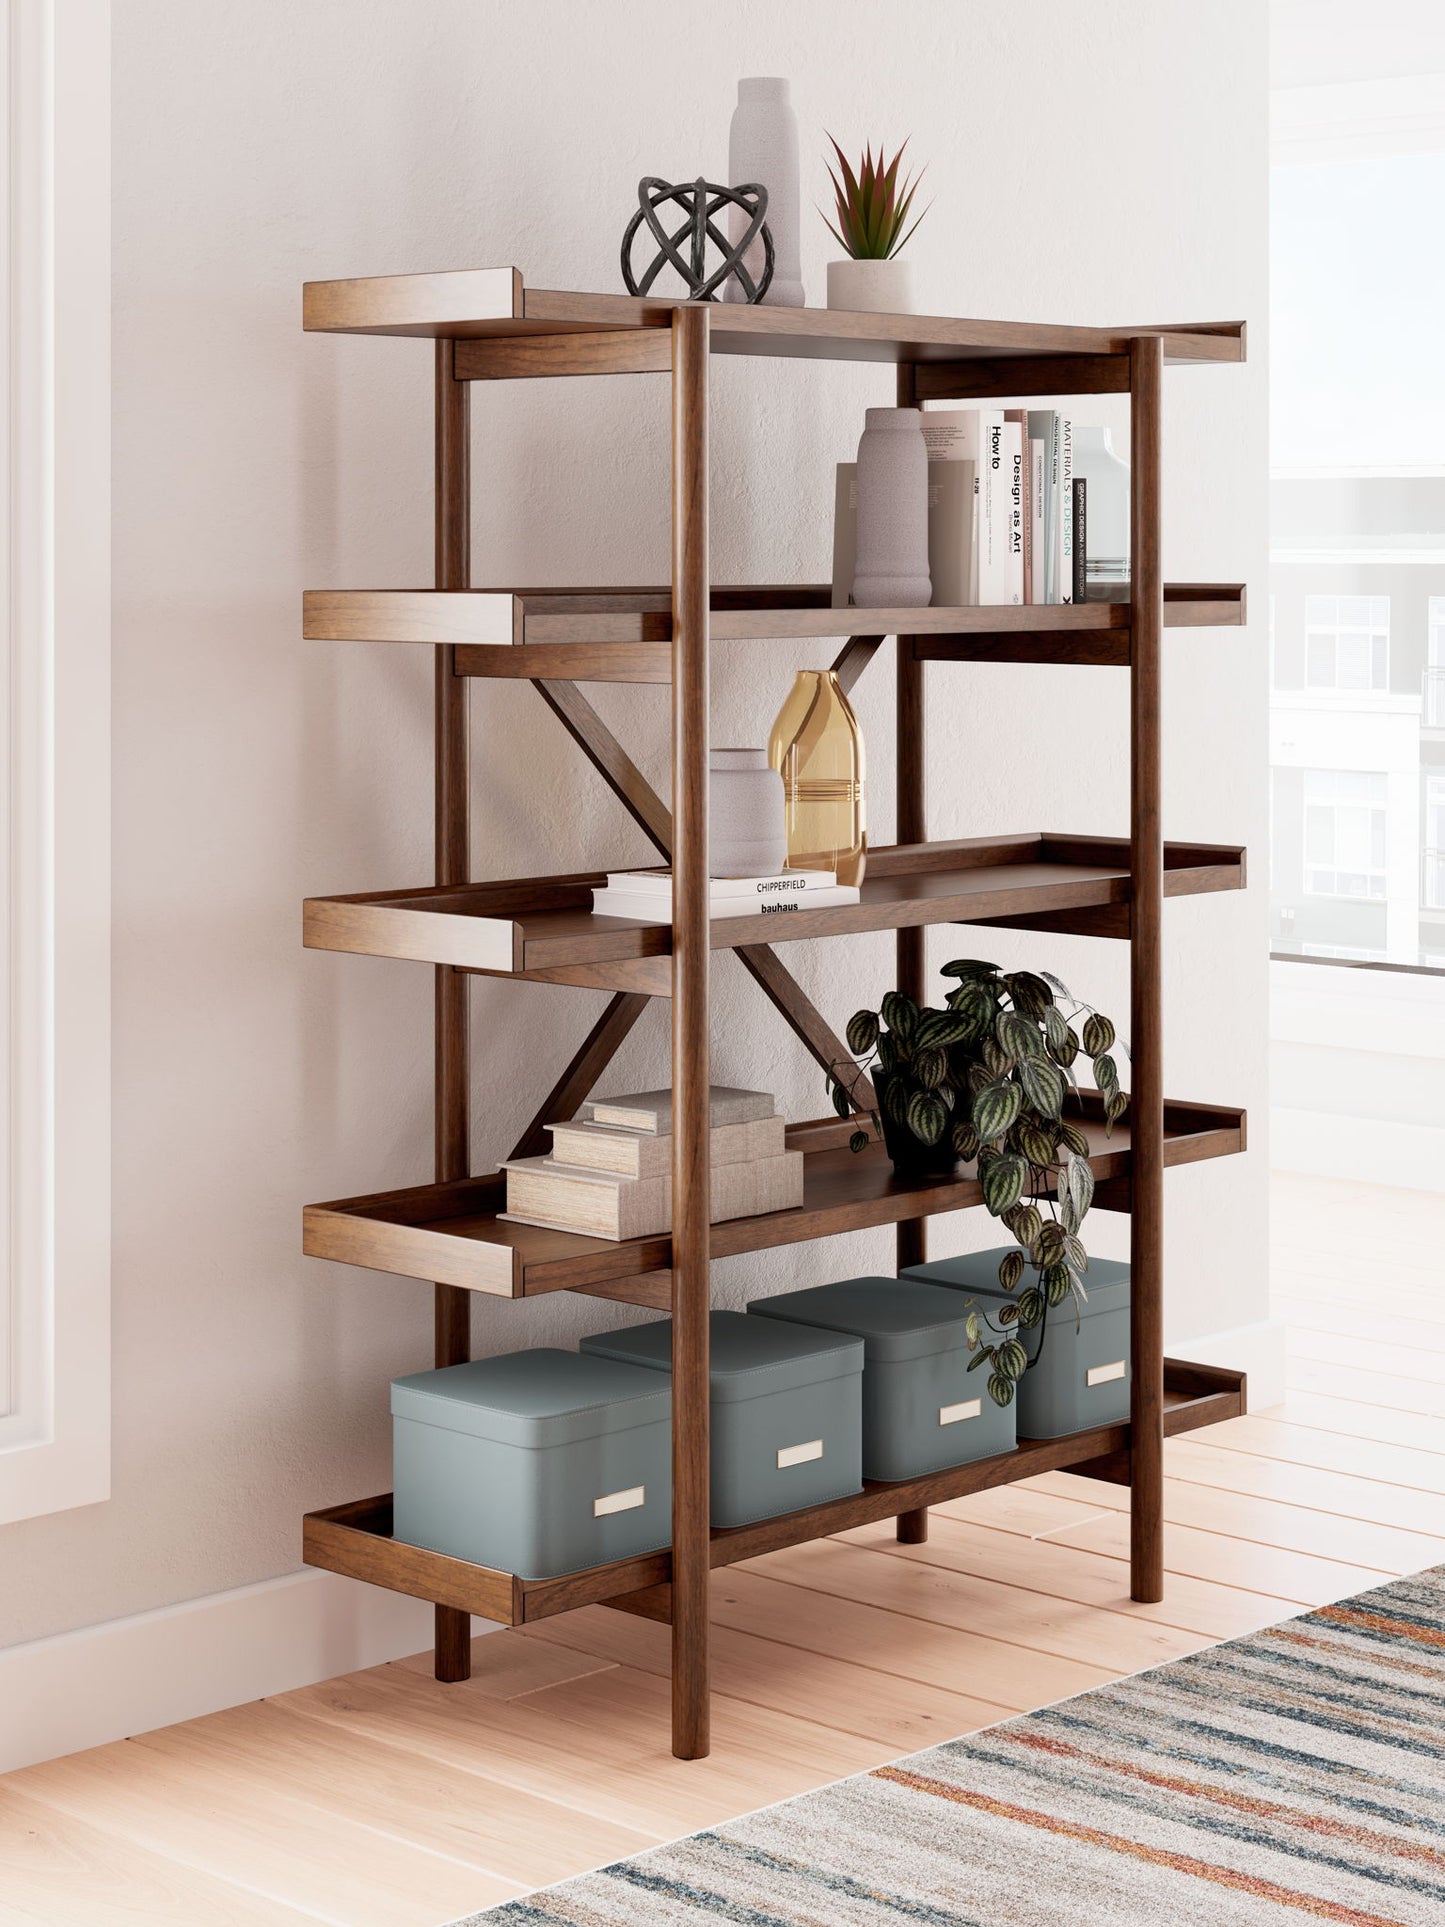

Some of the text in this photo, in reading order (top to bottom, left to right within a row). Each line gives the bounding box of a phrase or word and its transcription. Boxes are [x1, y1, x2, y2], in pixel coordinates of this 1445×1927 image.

[992, 426, 1001, 470] How to
[1011, 454, 1022, 554] Design as Art
[1063, 420, 1072, 556] MATERIALS & DESIGN
[756, 879, 806, 893] CHIPPERFIELD
[761, 903, 799, 914] bauhaus
